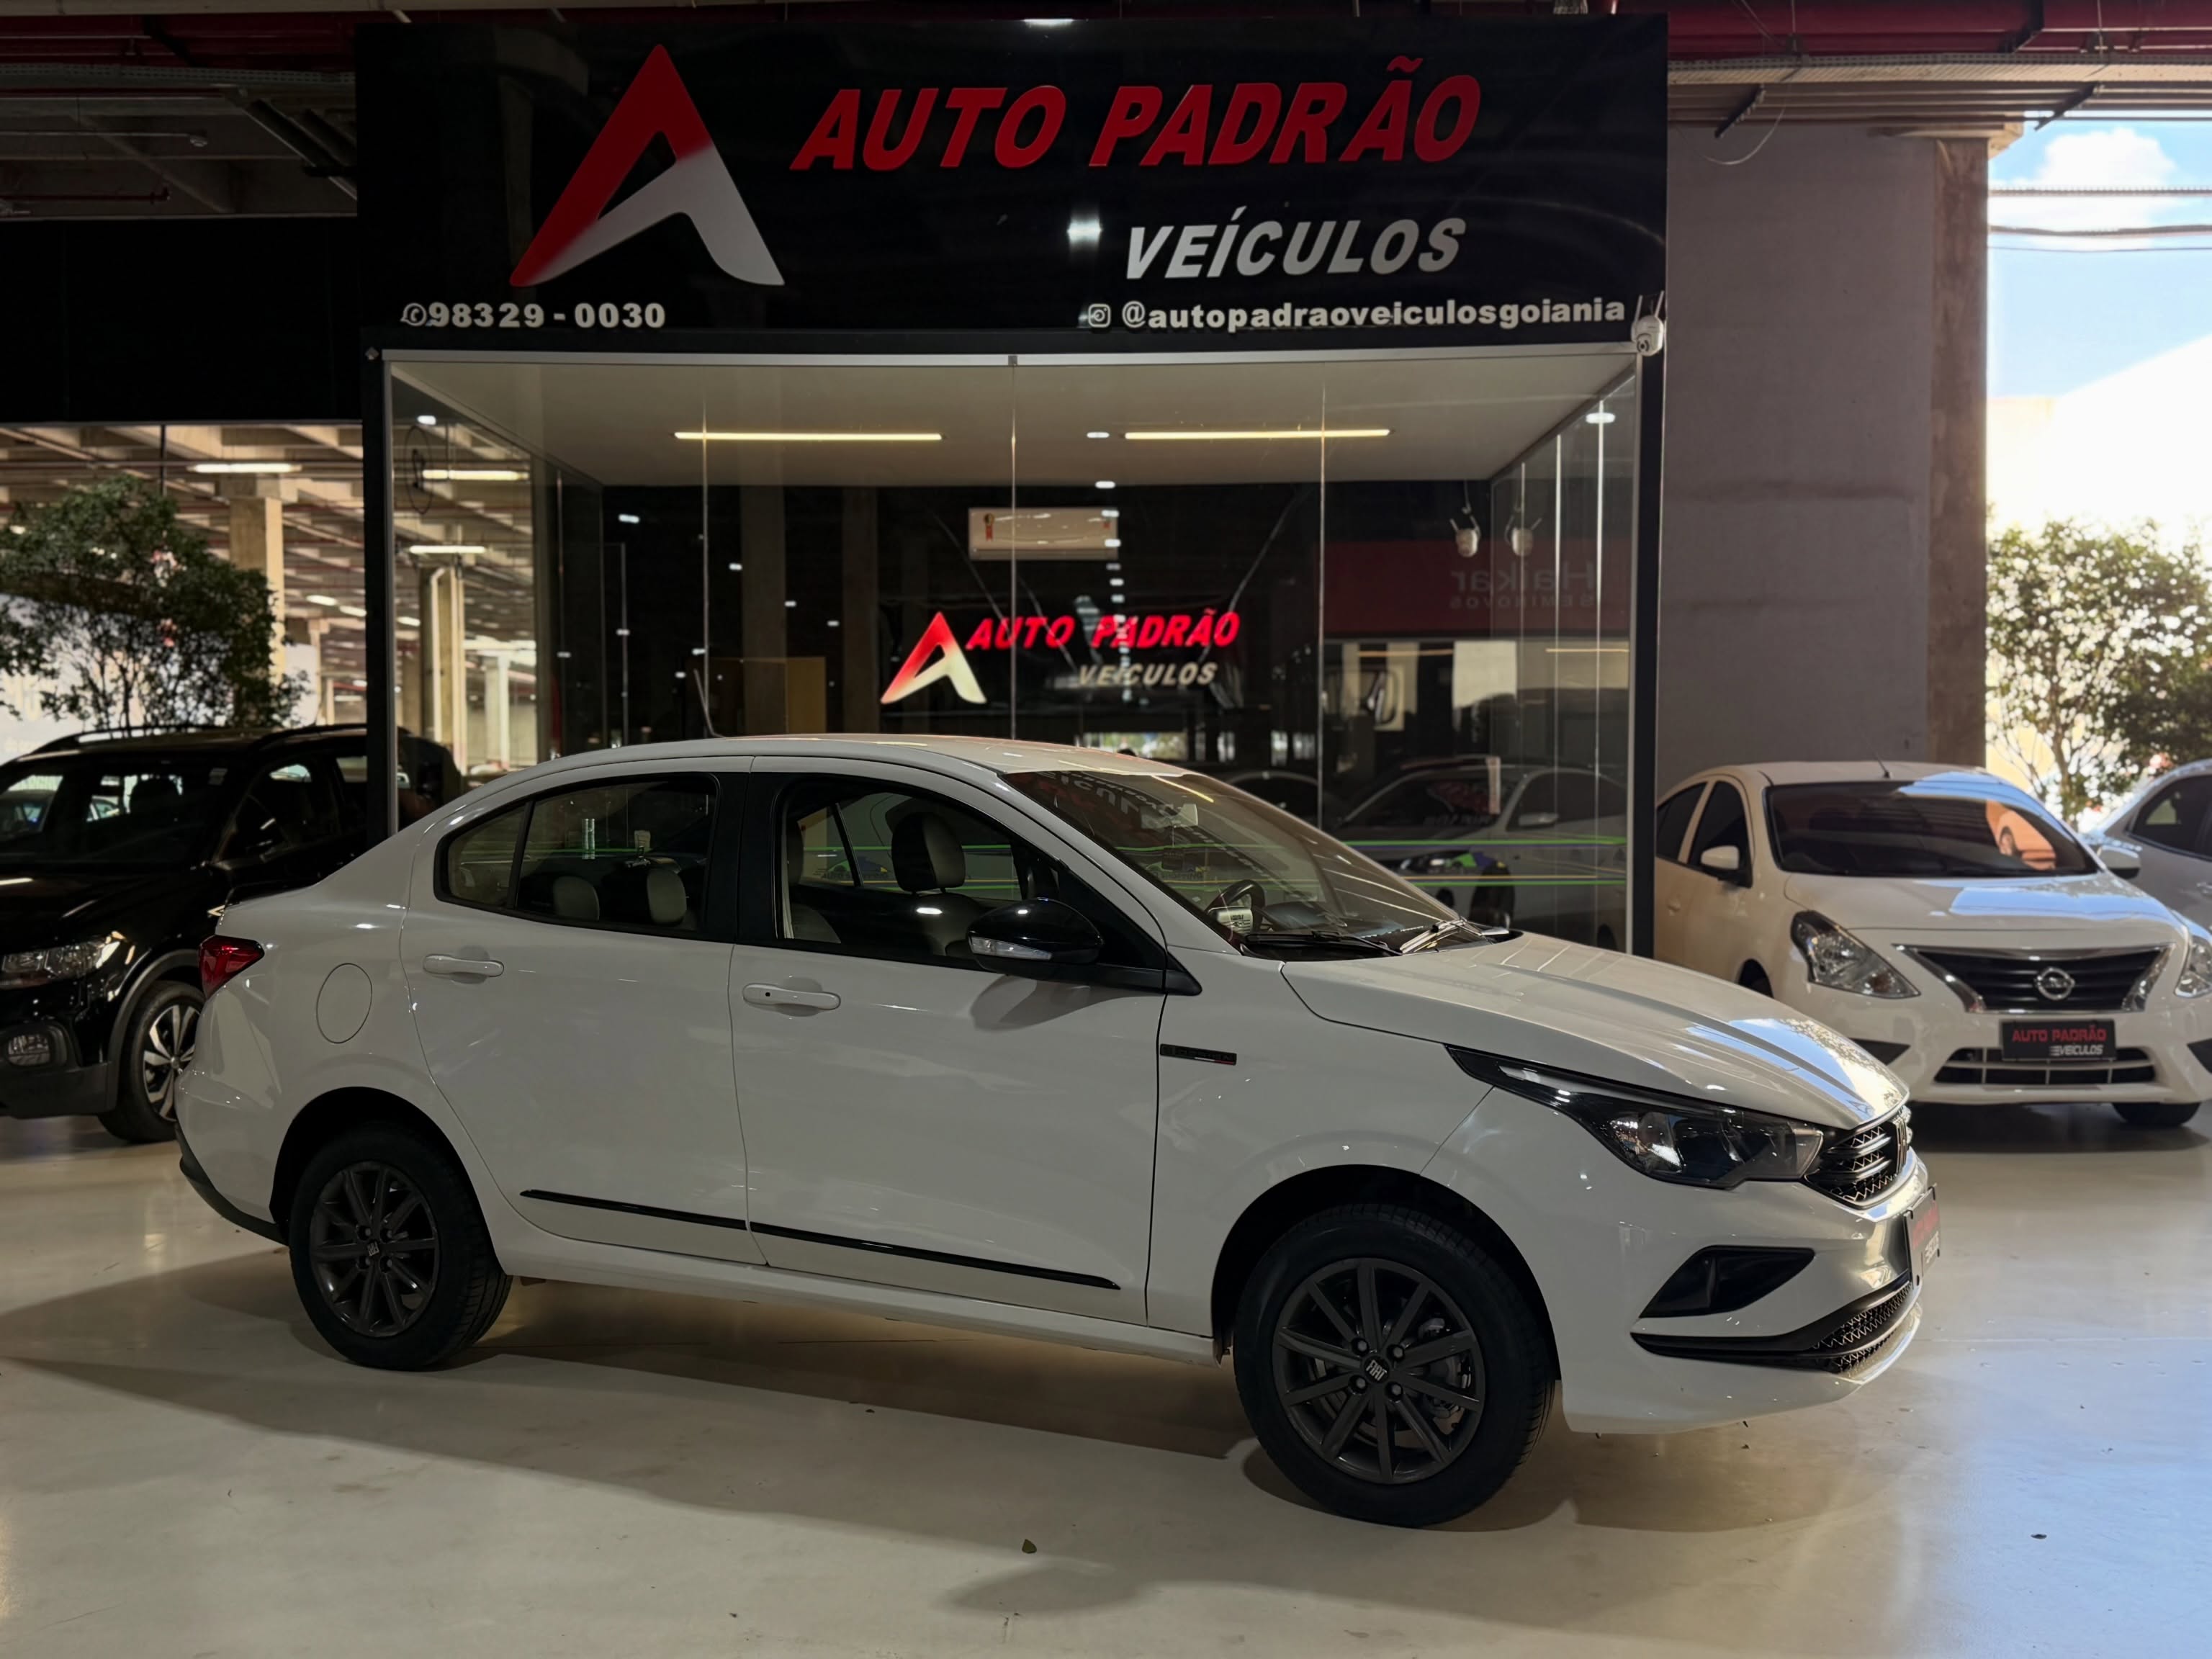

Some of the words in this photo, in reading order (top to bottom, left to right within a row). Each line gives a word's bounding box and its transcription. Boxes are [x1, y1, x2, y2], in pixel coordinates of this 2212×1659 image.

[790, 86, 1067, 171] AUTO
[1088, 55, 1481, 168] PADRÃO
[1125, 205, 1467, 280] VEÍCULOS
[1122, 299, 1625, 333] @autopadraoveiculosgoiania
[966, 616, 1076, 652] AUTO
[1090, 608, 1241, 649] PADRÃO
[2012, 1028, 2049, 1042] AUTO
[2051, 1024, 2107, 1042] PADRÃO
[1366, 1359, 1388, 1381] FIAT
